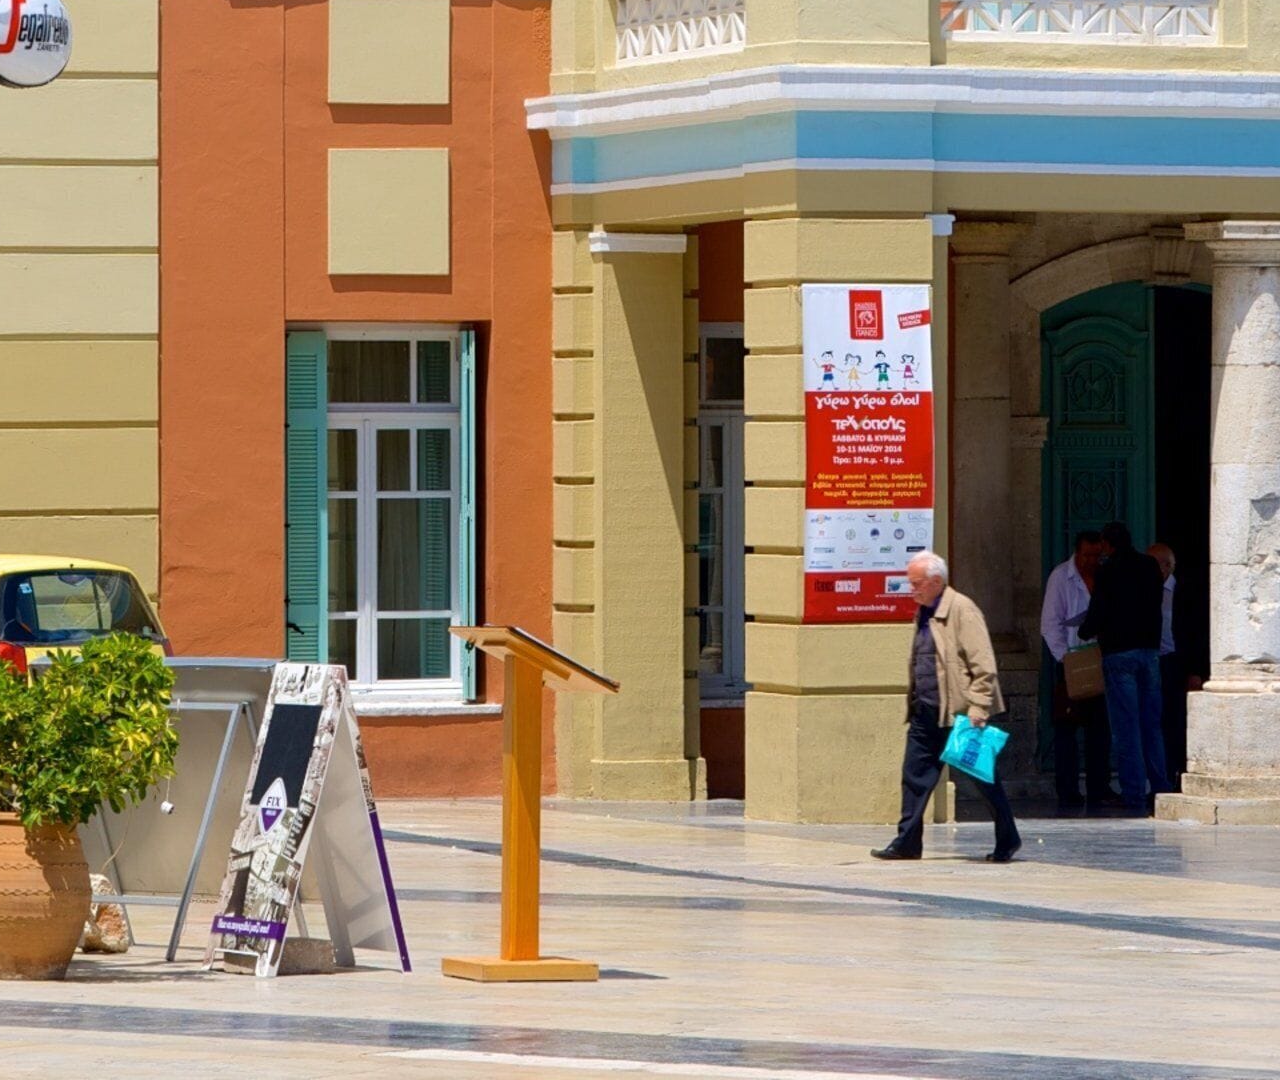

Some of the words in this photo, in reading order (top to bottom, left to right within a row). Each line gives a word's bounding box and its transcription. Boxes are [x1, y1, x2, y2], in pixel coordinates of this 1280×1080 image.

[815, 393, 849, 410] γύρω
[852, 393, 887, 410] γύρω
[266, 796, 282, 807] FIX
